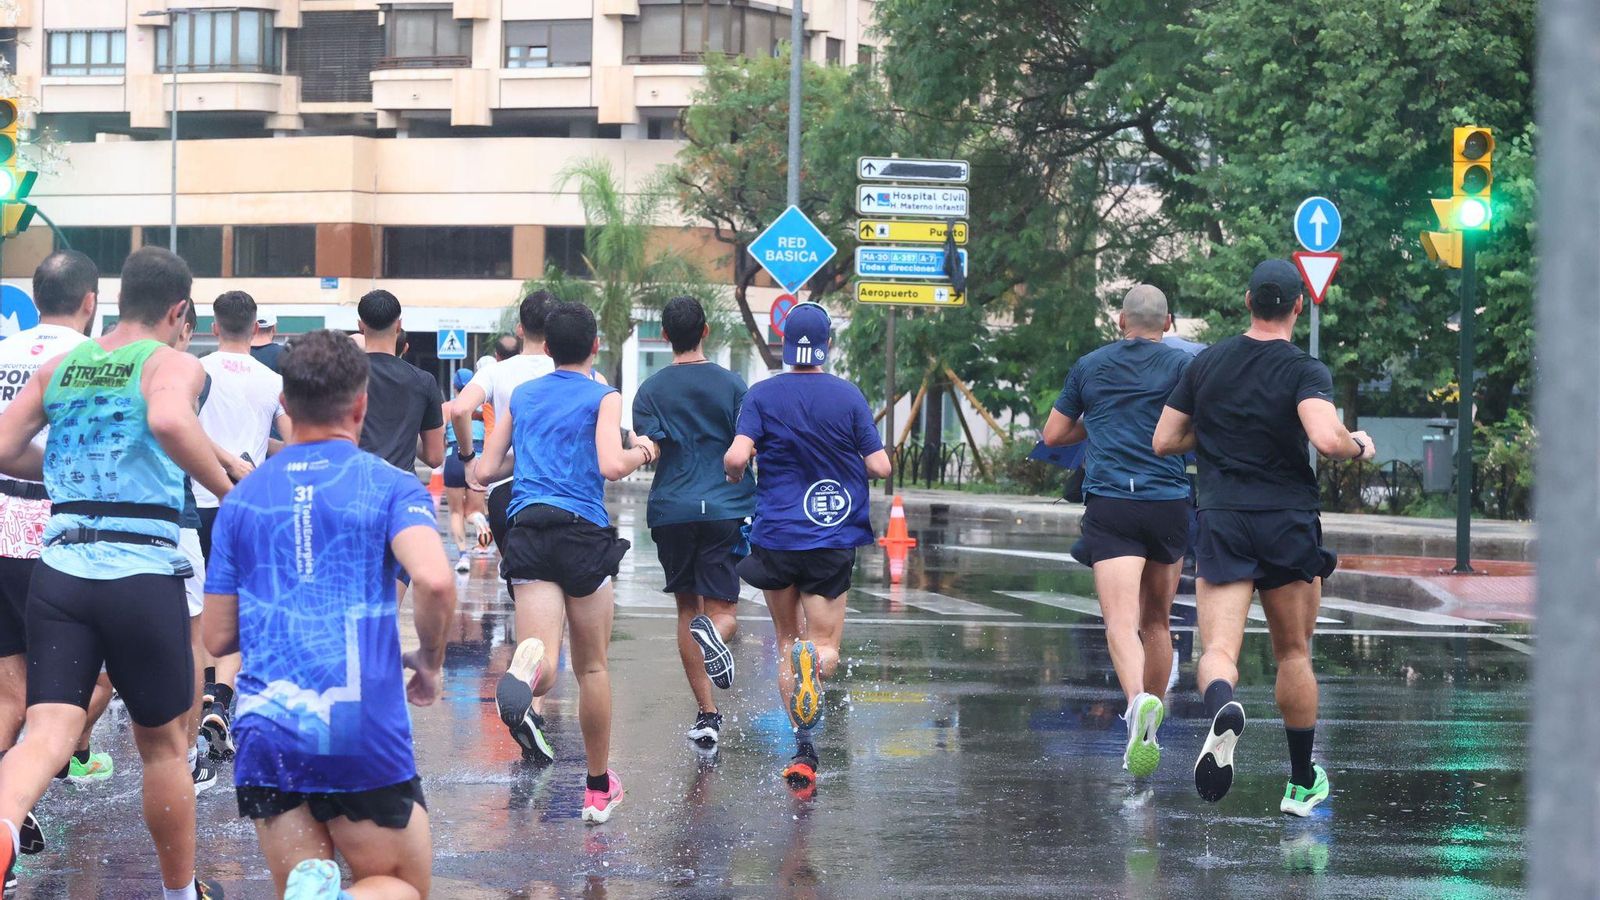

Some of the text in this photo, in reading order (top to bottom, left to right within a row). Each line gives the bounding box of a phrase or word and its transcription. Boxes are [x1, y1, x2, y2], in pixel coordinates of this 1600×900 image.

[893, 191, 965, 202] Hospital Civil
[930, 228, 964, 237] Pueto
[778, 236, 807, 248] RED
[765, 250, 818, 262] BASICA
[860, 263, 936, 272] Todas direcciones
[860, 288, 918, 298] Aeropuerto
[294, 485, 313, 501] 31
[302, 503, 314, 574] TotalEnergies
